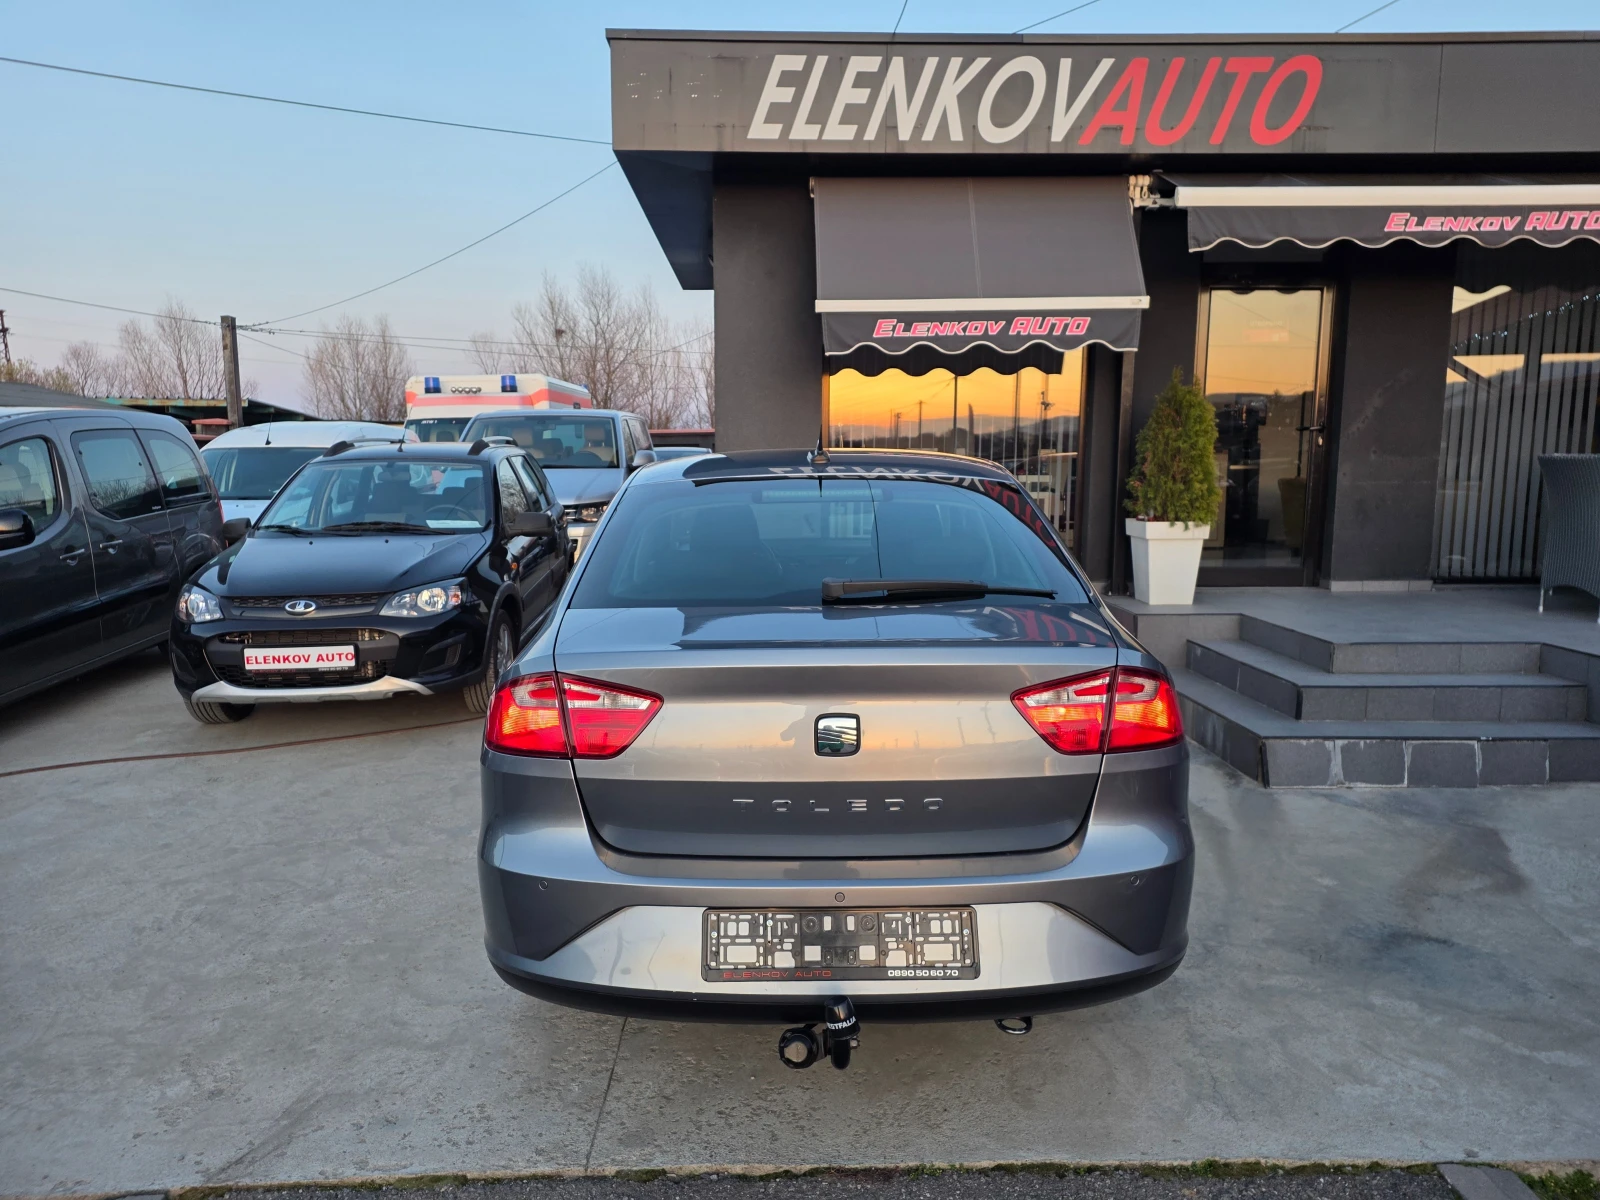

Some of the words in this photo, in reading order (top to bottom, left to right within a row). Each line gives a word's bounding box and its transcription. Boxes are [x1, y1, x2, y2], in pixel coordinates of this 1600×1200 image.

[1009, 316, 1091, 335] AUTO
[245, 654, 311, 665] ELENKOV
[316, 652, 355, 662] AUTO
[732, 798, 944, 813] TOLEDO
[723, 970, 789, 979] ELENKOV
[794, 970, 832, 978] AUTO
[887, 969, 915, 977] 0890
[915, 969, 930, 977] 50
[944, 969, 959, 977] 70
[826, 1015, 857, 1030] ESTFALIA
